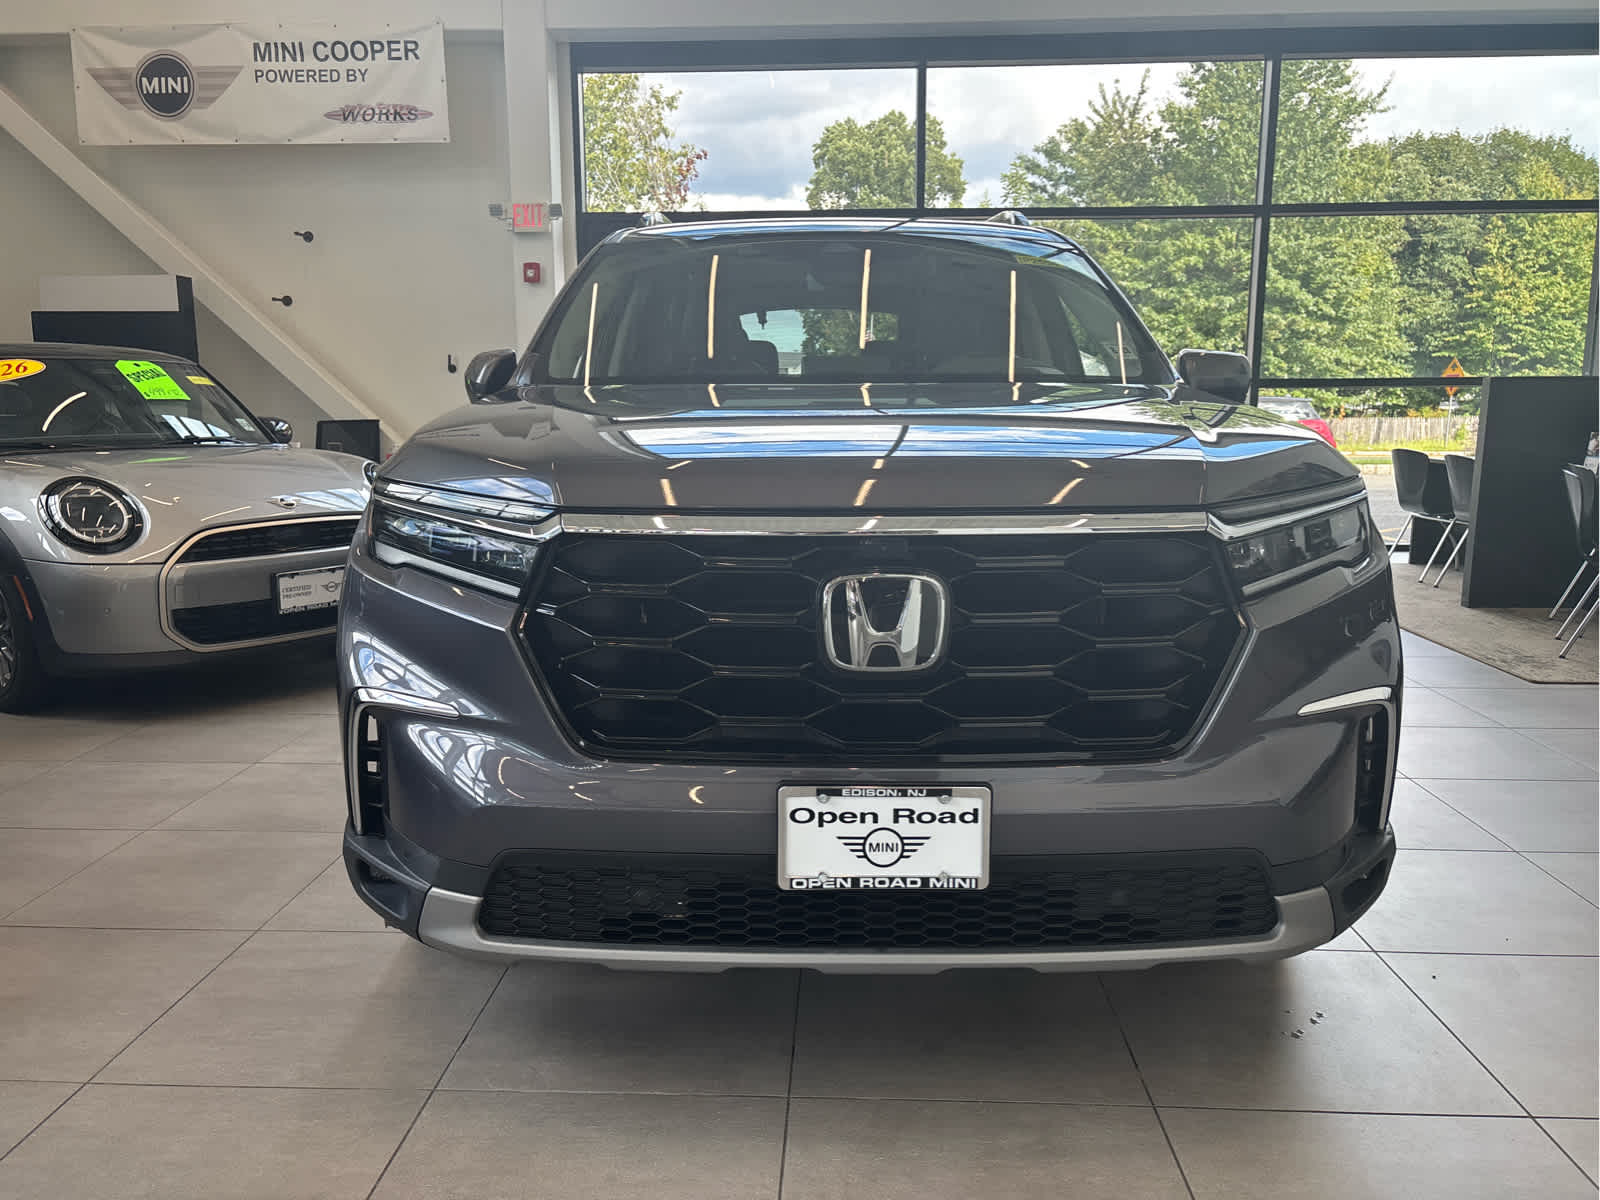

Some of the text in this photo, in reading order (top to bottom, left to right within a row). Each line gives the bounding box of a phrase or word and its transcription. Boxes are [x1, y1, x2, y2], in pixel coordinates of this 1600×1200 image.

[252, 40, 420, 63] MINI COOPER
[254, 68, 369, 83] POWERED BY
[140, 76, 190, 95] MINI
[342, 107, 418, 122] WORKS
[512, 203, 544, 228] EXIT
[907, 788, 927, 797] NJ
[789, 807, 979, 828] Open Road
[868, 842, 899, 853] MINI
[791, 877, 977, 889] OPEN ROAD MINI
